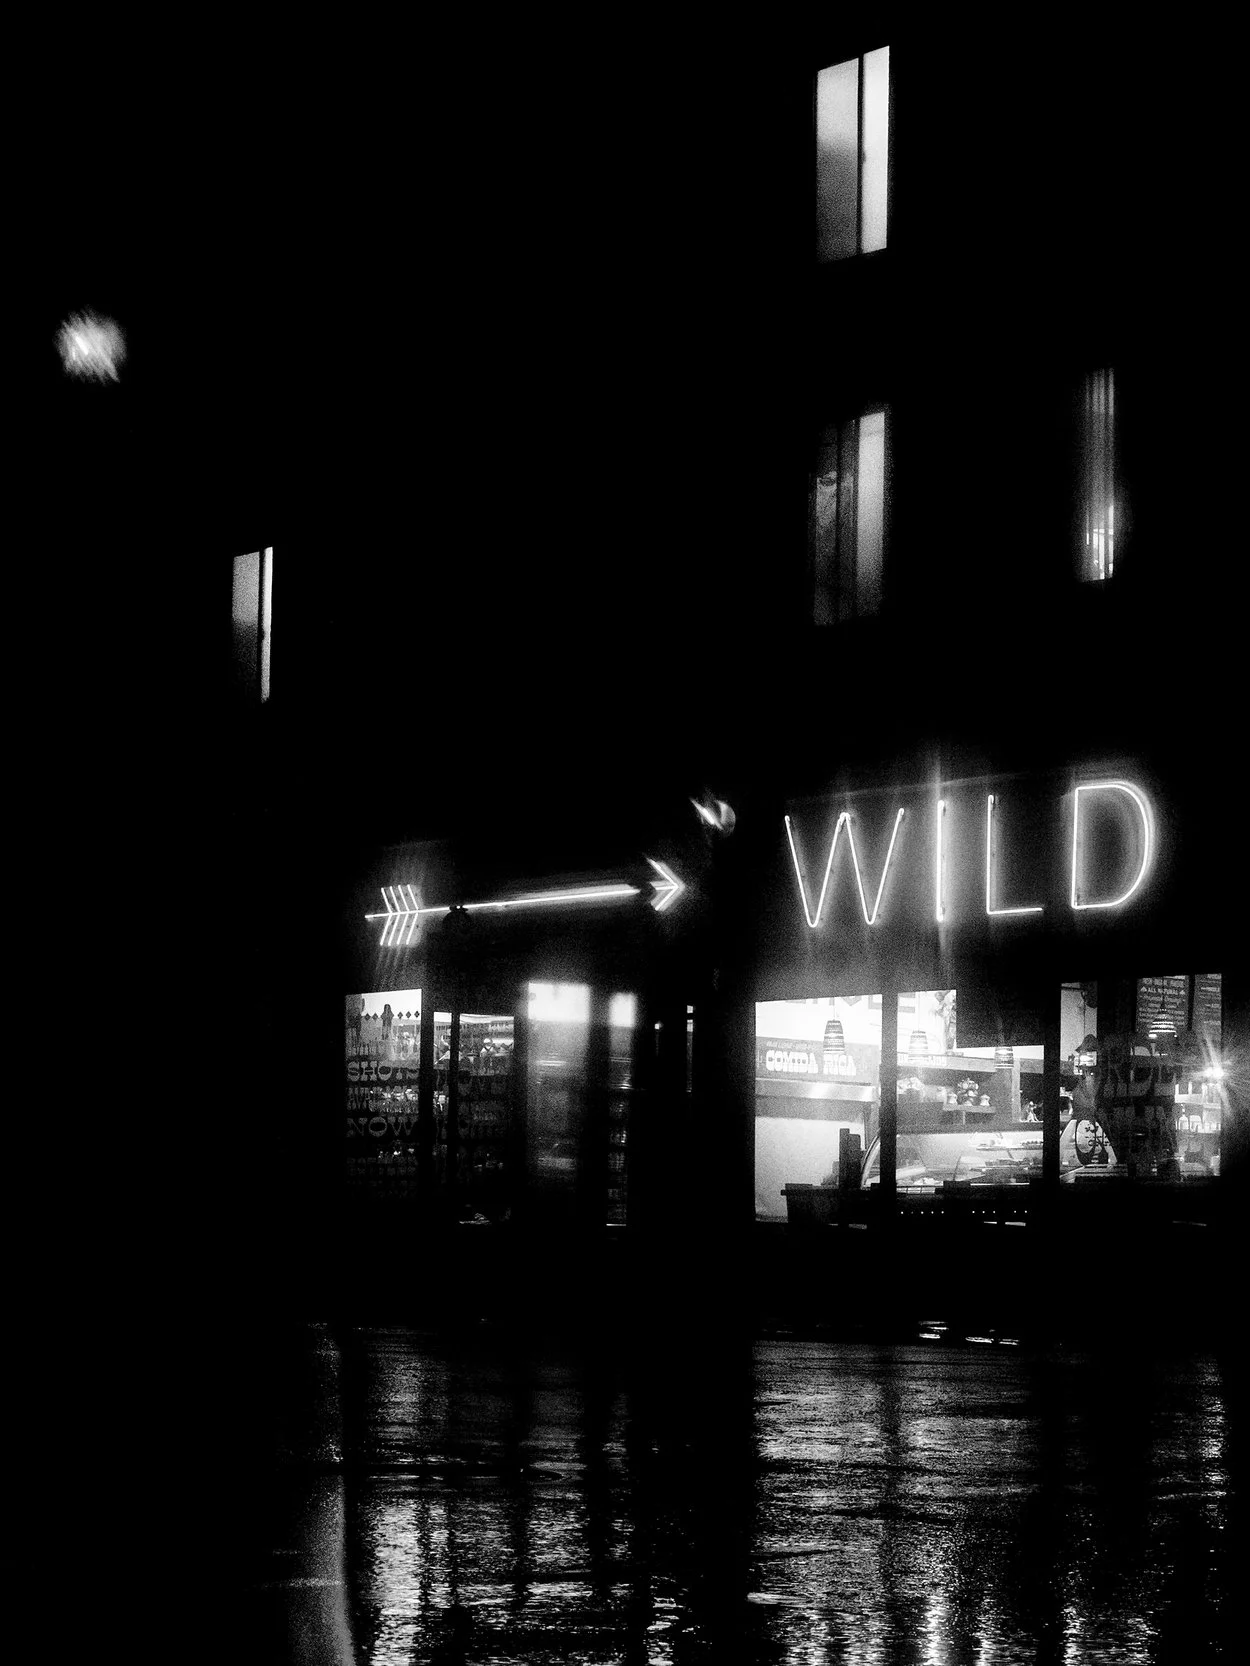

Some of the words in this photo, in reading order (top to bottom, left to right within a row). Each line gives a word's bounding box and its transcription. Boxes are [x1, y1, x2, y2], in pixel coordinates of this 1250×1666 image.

[784, 779, 1155, 927] WILD
[765, 1049, 819, 1074] COMIDA
[346, 1116, 419, 1138] NOW
